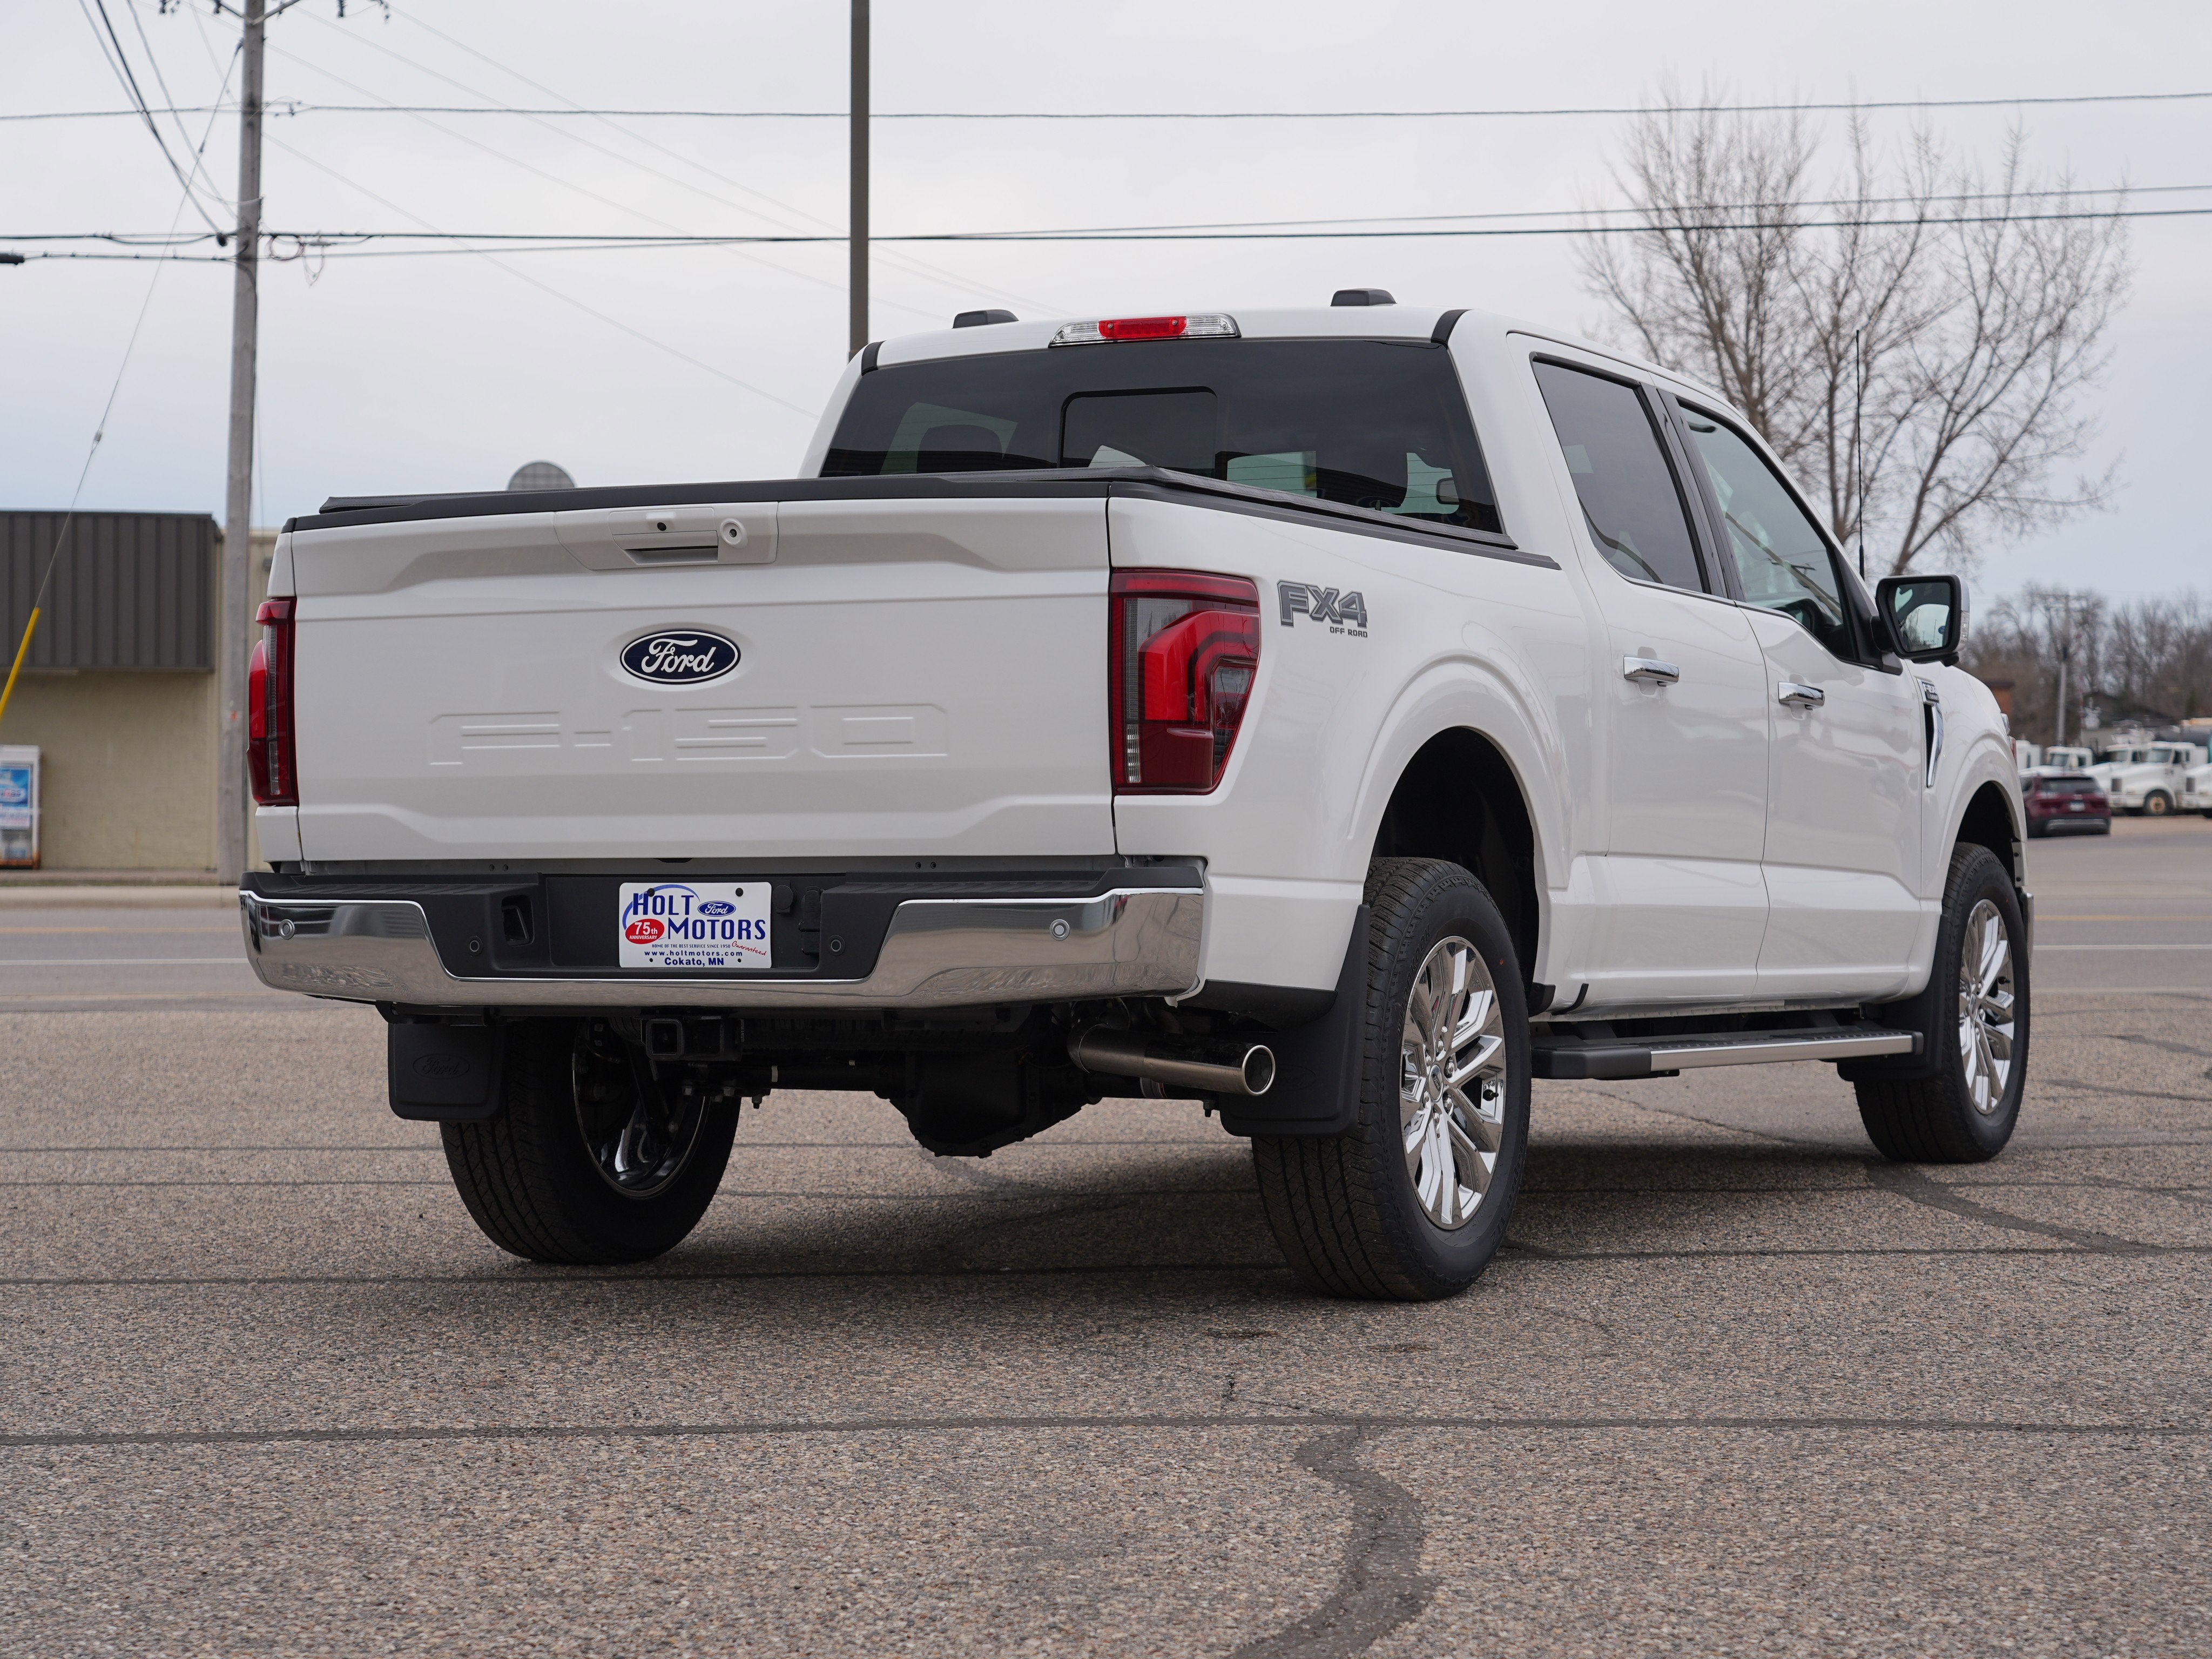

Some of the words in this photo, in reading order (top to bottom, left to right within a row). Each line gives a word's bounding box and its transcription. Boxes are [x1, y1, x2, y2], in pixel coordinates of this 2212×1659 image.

[1277, 579, 1368, 629] FX4
[1330, 626, 1345, 635] OFF
[1348, 629, 1368, 638] ROAD
[641, 638, 717, 673] Ford
[430, 703, 948, 766] F-150
[632, 893, 694, 915] HOLT
[634, 922, 658, 935] 75th
[668, 917, 766, 940] MOTORS
[732, 941, 767, 956] Guaranteed
[665, 957, 705, 967] Cokato,
[708, 957, 724, 966] MN
[423, 1056, 460, 1075] Ford
